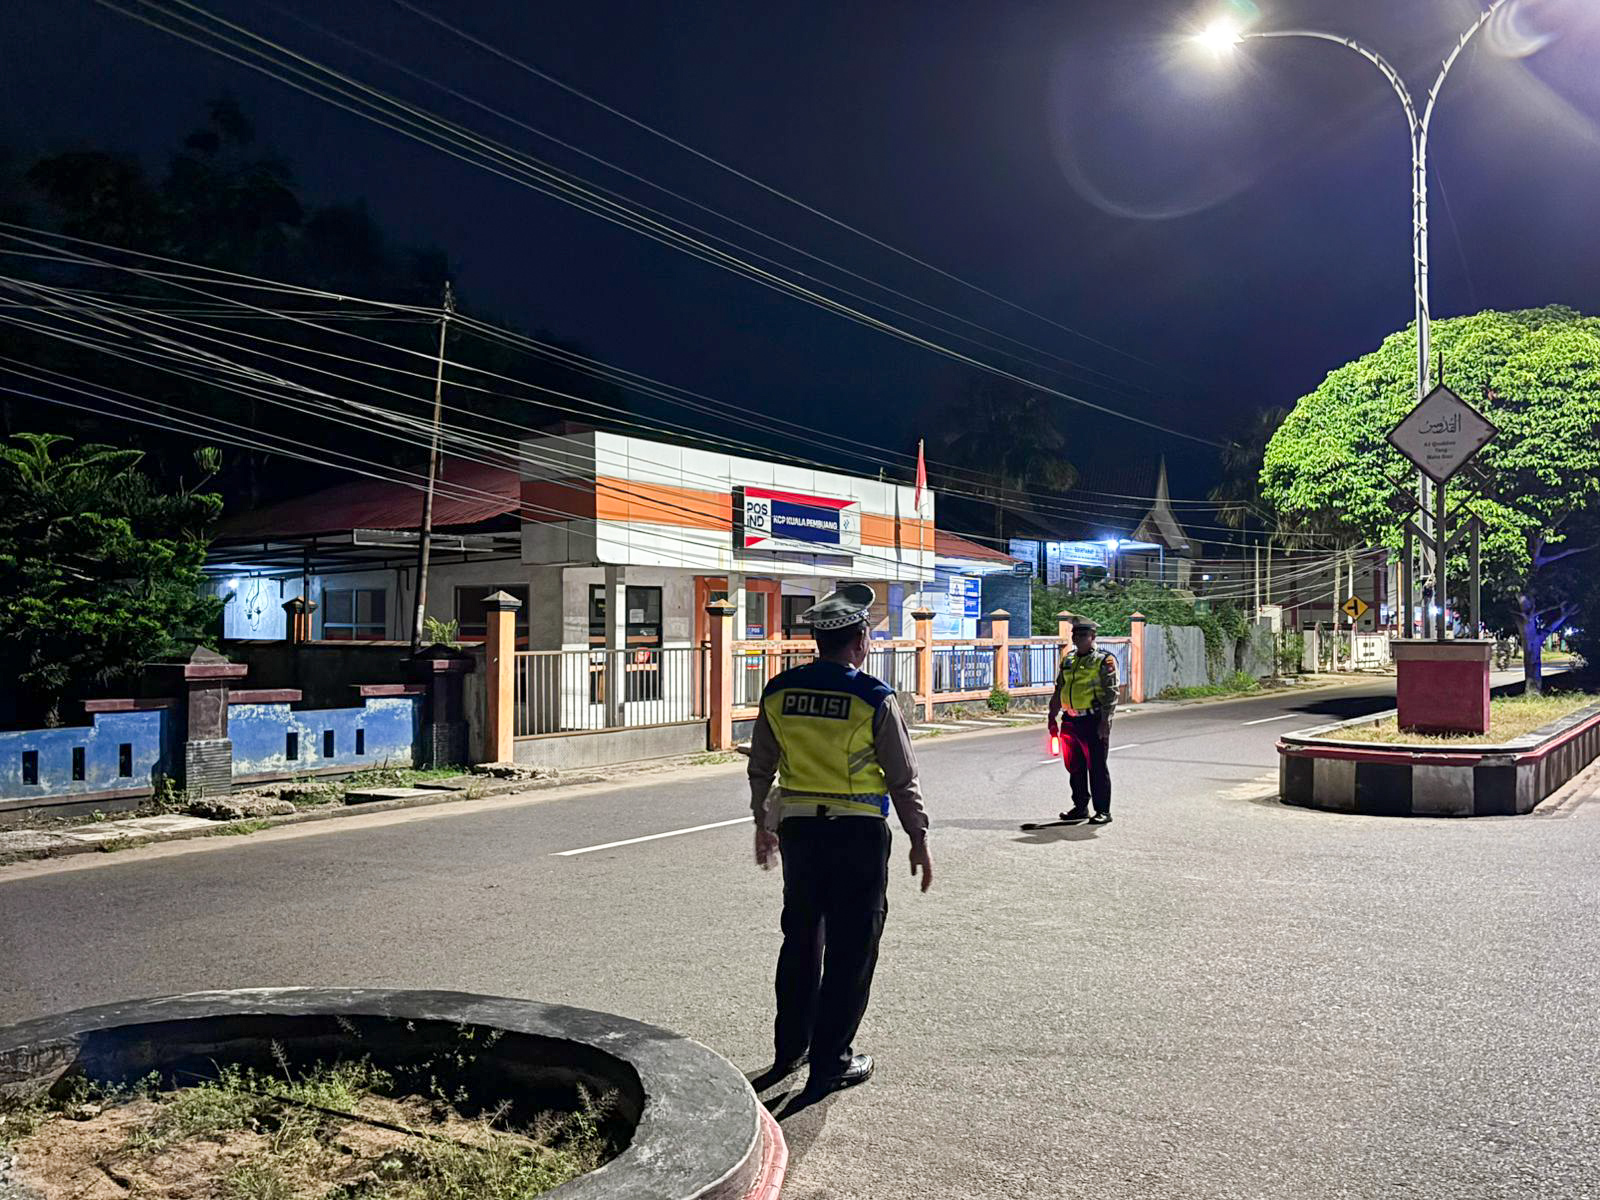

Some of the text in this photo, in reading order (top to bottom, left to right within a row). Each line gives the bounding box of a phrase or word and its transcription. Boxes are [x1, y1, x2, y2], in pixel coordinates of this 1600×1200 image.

[747, 502, 768, 515] POS
[773, 515, 838, 530] KCP KUALA PEMBUANG
[785, 695, 848, 716] POLISI
